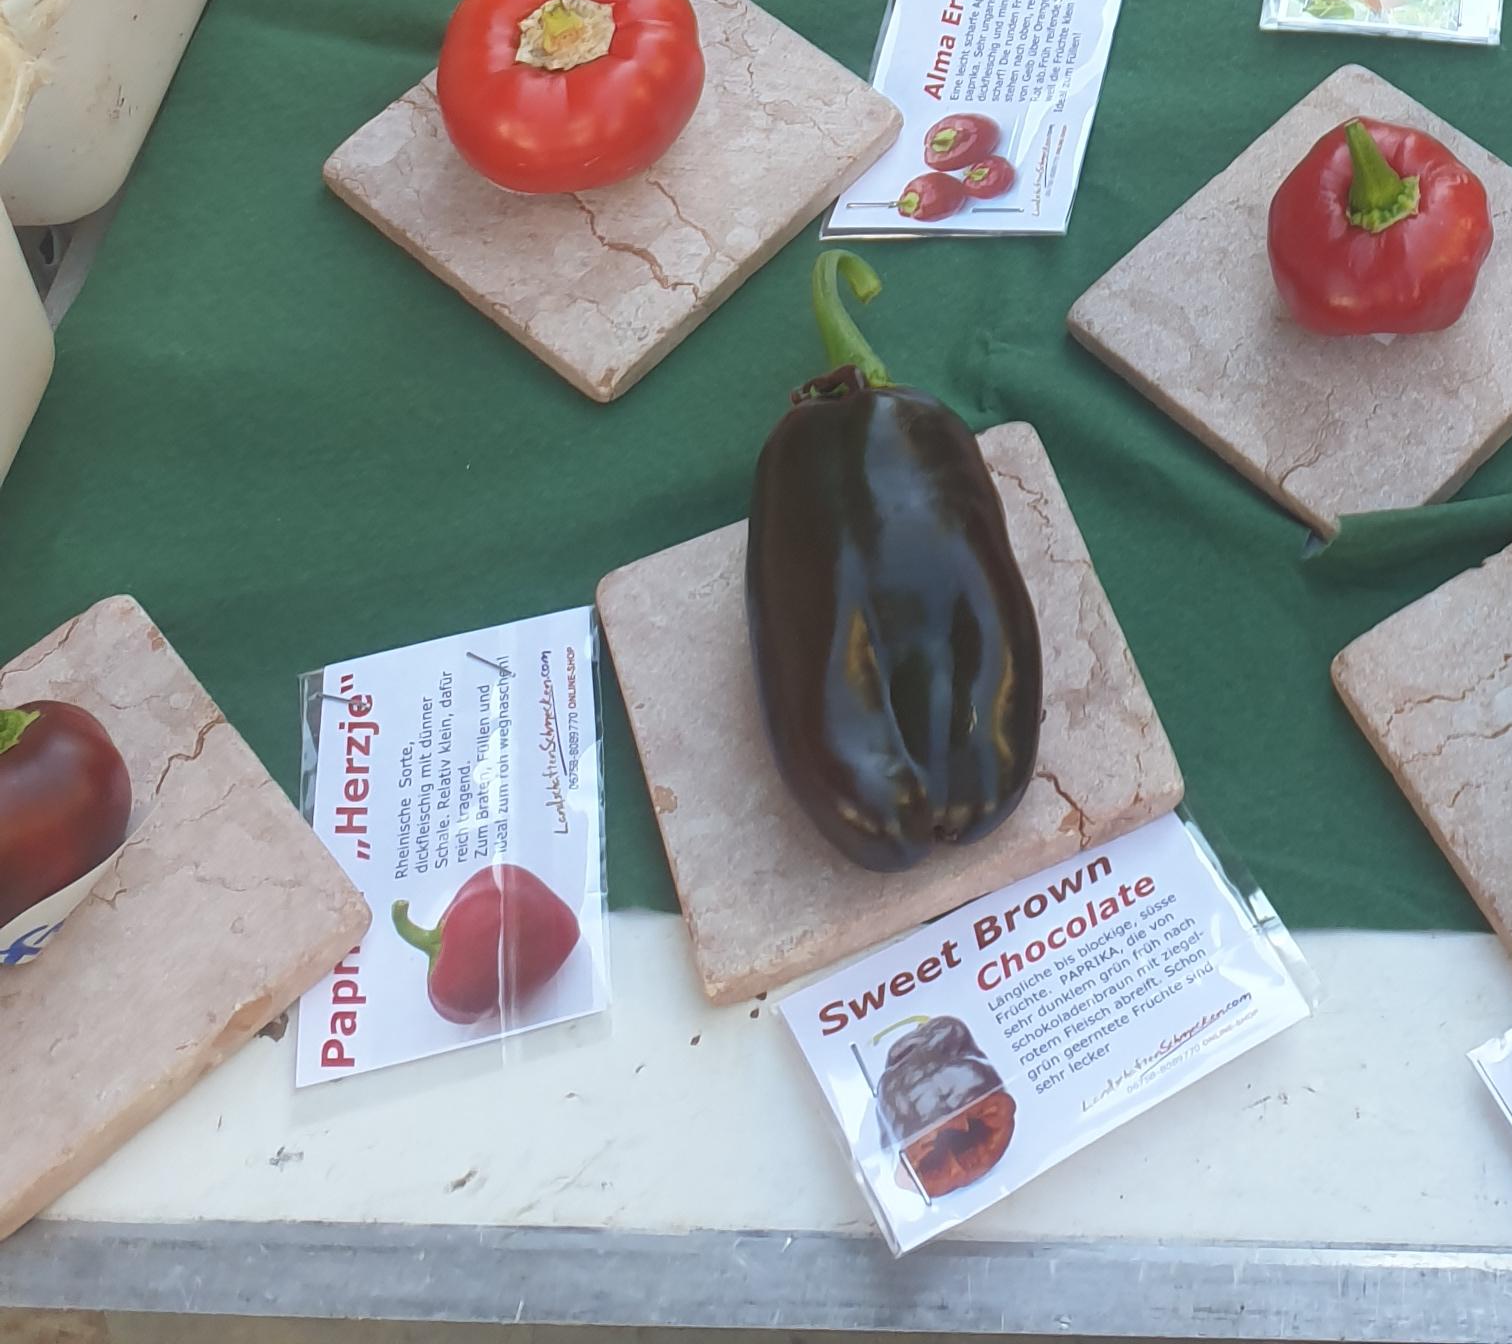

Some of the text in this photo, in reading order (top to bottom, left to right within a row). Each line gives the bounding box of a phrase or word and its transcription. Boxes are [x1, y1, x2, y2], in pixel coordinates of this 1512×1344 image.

[921, 37, 955, 100] Alma
[567, 646, 576, 708] ONLINE-SHOP
[395, 740, 414, 879] Rheinische Sorte,
[415, 695, 433, 873] dickfleischig mit dünner
[435, 670, 453, 869] Schale. Relativ klein, dafür
[455, 761, 472, 862] reich tragend.
[475, 685, 490, 857] Zum Braten, Füllen und
[499, 784, 507, 814] zum
[816, 860, 1111, 1034] Sweet Brown
[972, 877, 1154, 990] Chocolate
[986, 894, 1176, 1011] Längliche bis blockige, süsse
[993, 913, 1173, 1023] Früchte. PAPRIKA, die von
[1002, 915, 1195, 1037] sehr dunklem grün früh nach
[1010, 930, 1204, 1051] schokoladenbraun mit ziegel-
[321, 947, 366, 1074] Papr
[1018, 949, 1205, 1065] rotem Fleisch abreift. Schon
[1026, 1055, 1060, 1083] grün
[1063, 1013, 1129, 1061] geerntete
[1185, 960, 1213, 984] sind
[1034, 1044, 1111, 1093] sehr lecker
